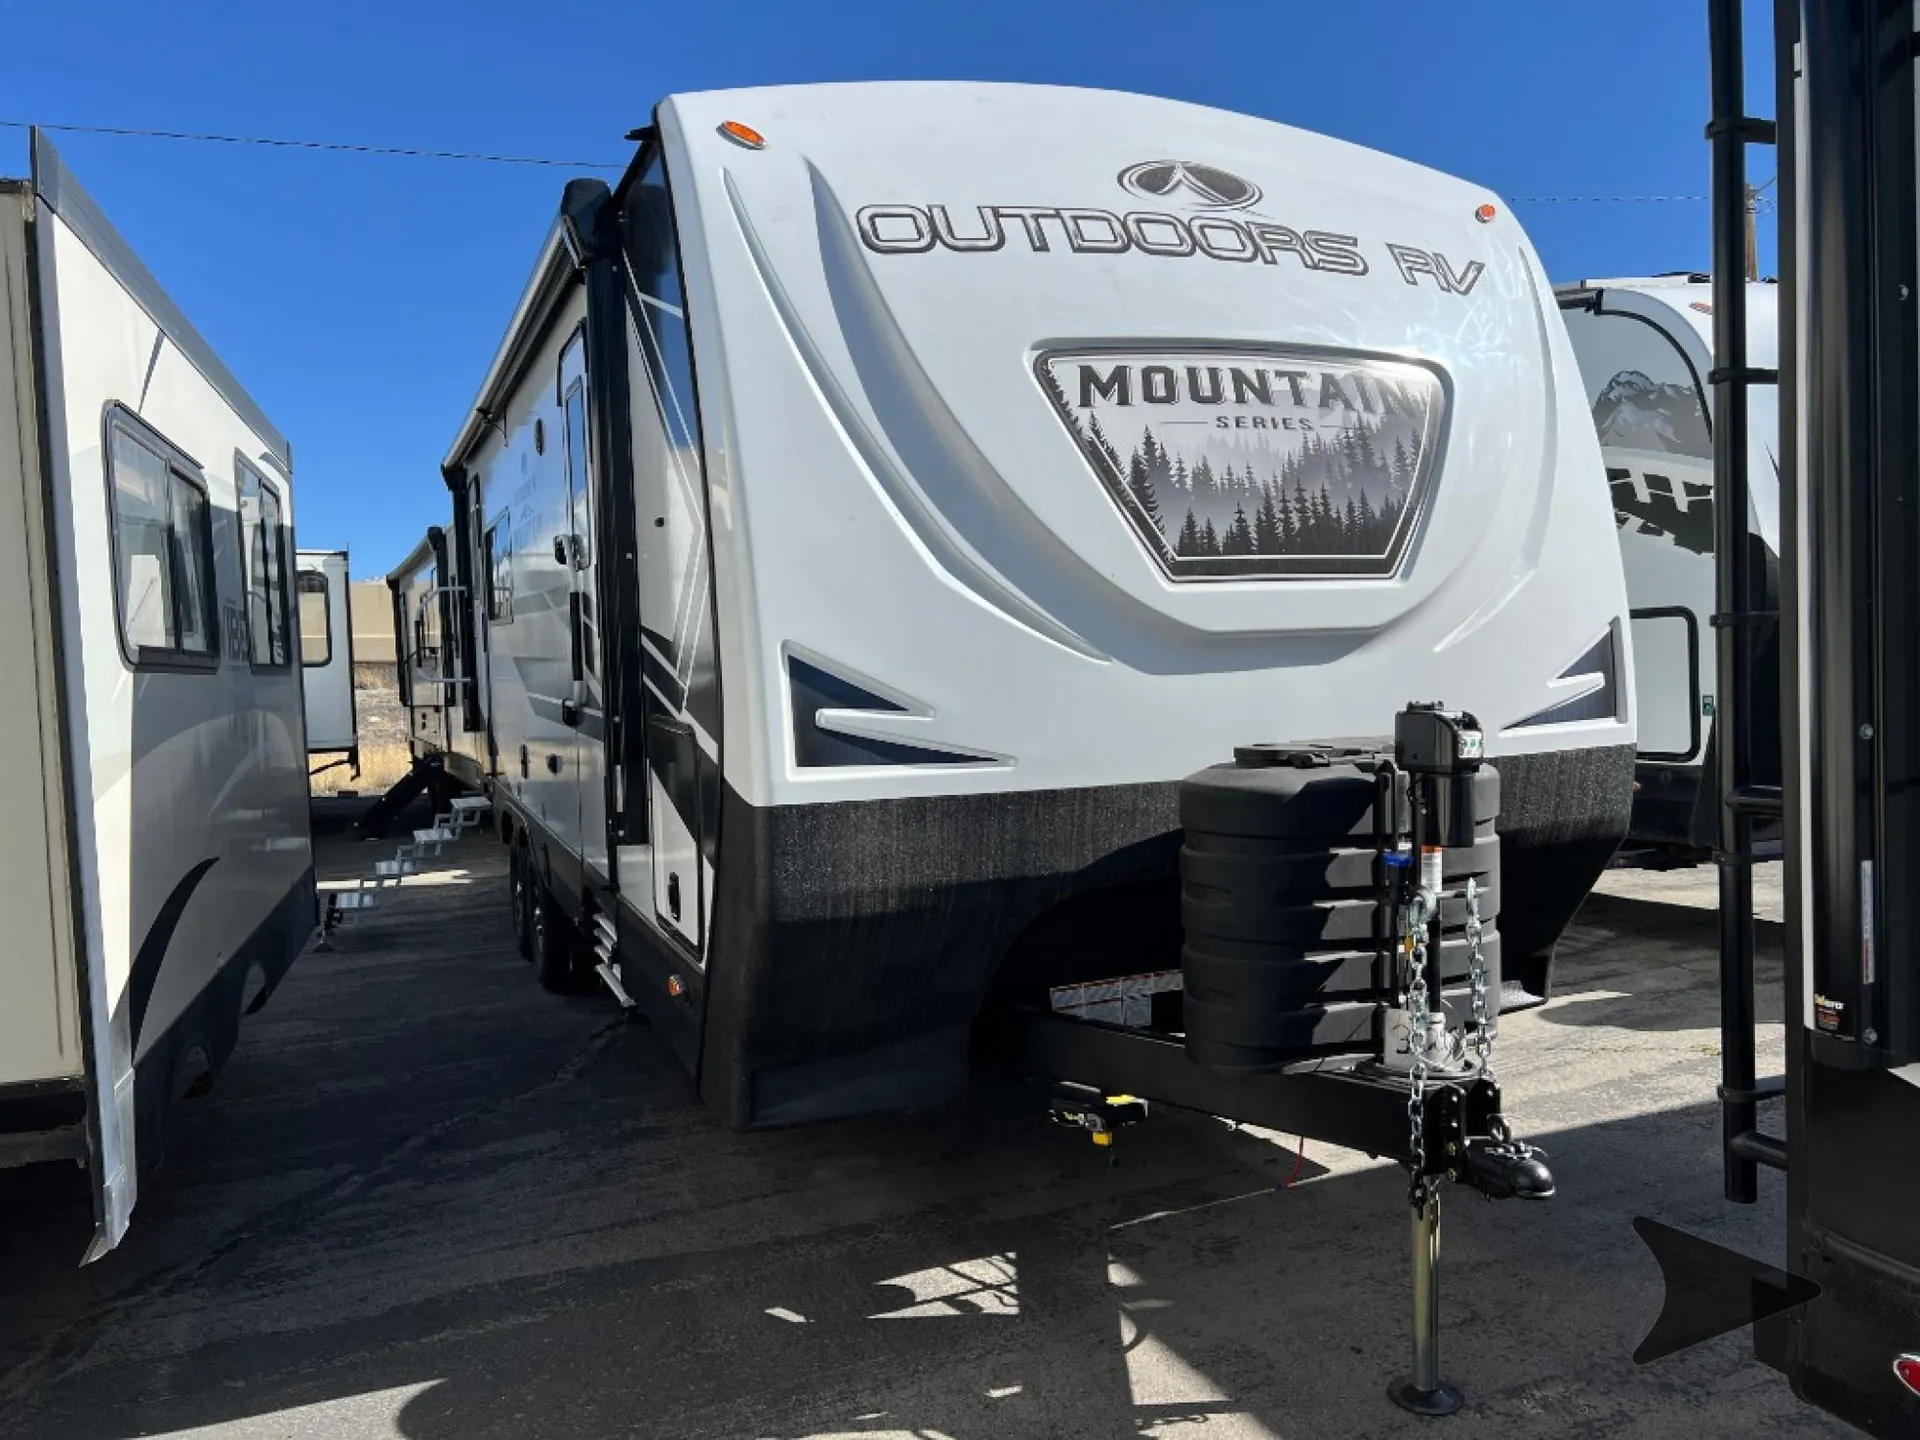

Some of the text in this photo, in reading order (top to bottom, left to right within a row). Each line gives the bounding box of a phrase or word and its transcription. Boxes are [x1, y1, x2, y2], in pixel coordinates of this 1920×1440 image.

[856, 204, 1485, 296] OUTDOORS RV
[1078, 364, 1418, 417] MOUNTAIN
[1216, 415, 1314, 431] SERIES
